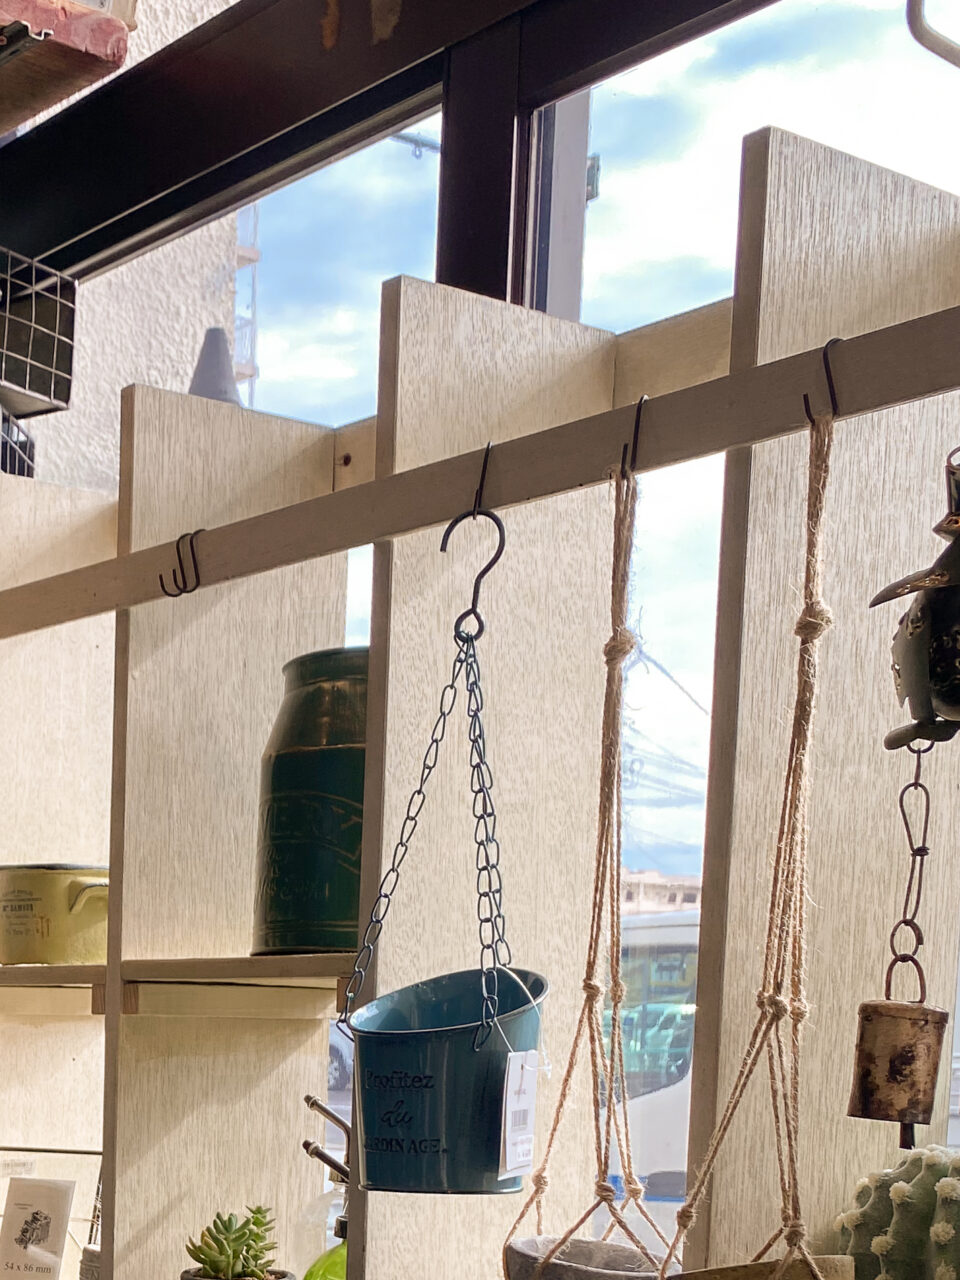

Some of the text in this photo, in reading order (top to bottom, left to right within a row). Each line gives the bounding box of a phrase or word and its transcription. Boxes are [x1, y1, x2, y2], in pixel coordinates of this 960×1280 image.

[4, 1261, 14, 1270] 54
[24, 1262, 34, 1272] 86
[35, 1265, 52, 1274] mm
